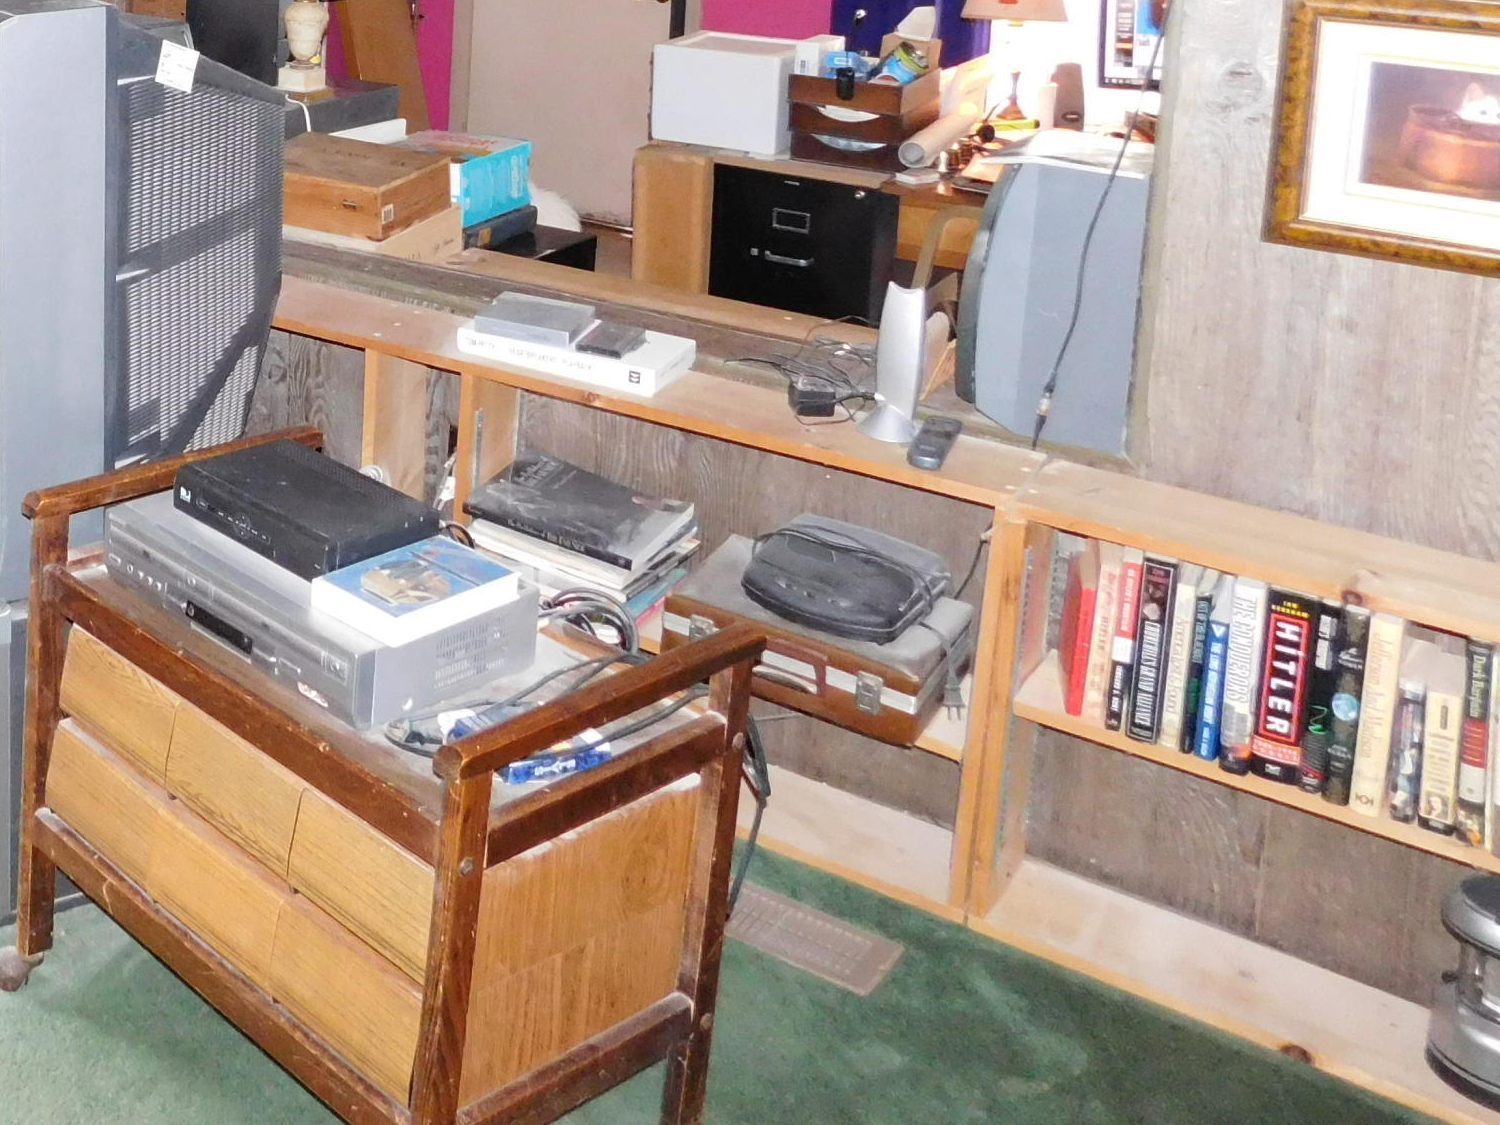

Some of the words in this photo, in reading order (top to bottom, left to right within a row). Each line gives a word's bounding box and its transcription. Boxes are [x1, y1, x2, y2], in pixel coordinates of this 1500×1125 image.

[1235, 595, 1257, 619] THE
[1138, 664, 1157, 691] GRAND
[1225, 620, 1253, 702] CONQUERORS
[1266, 621, 1301, 735] HITLER
